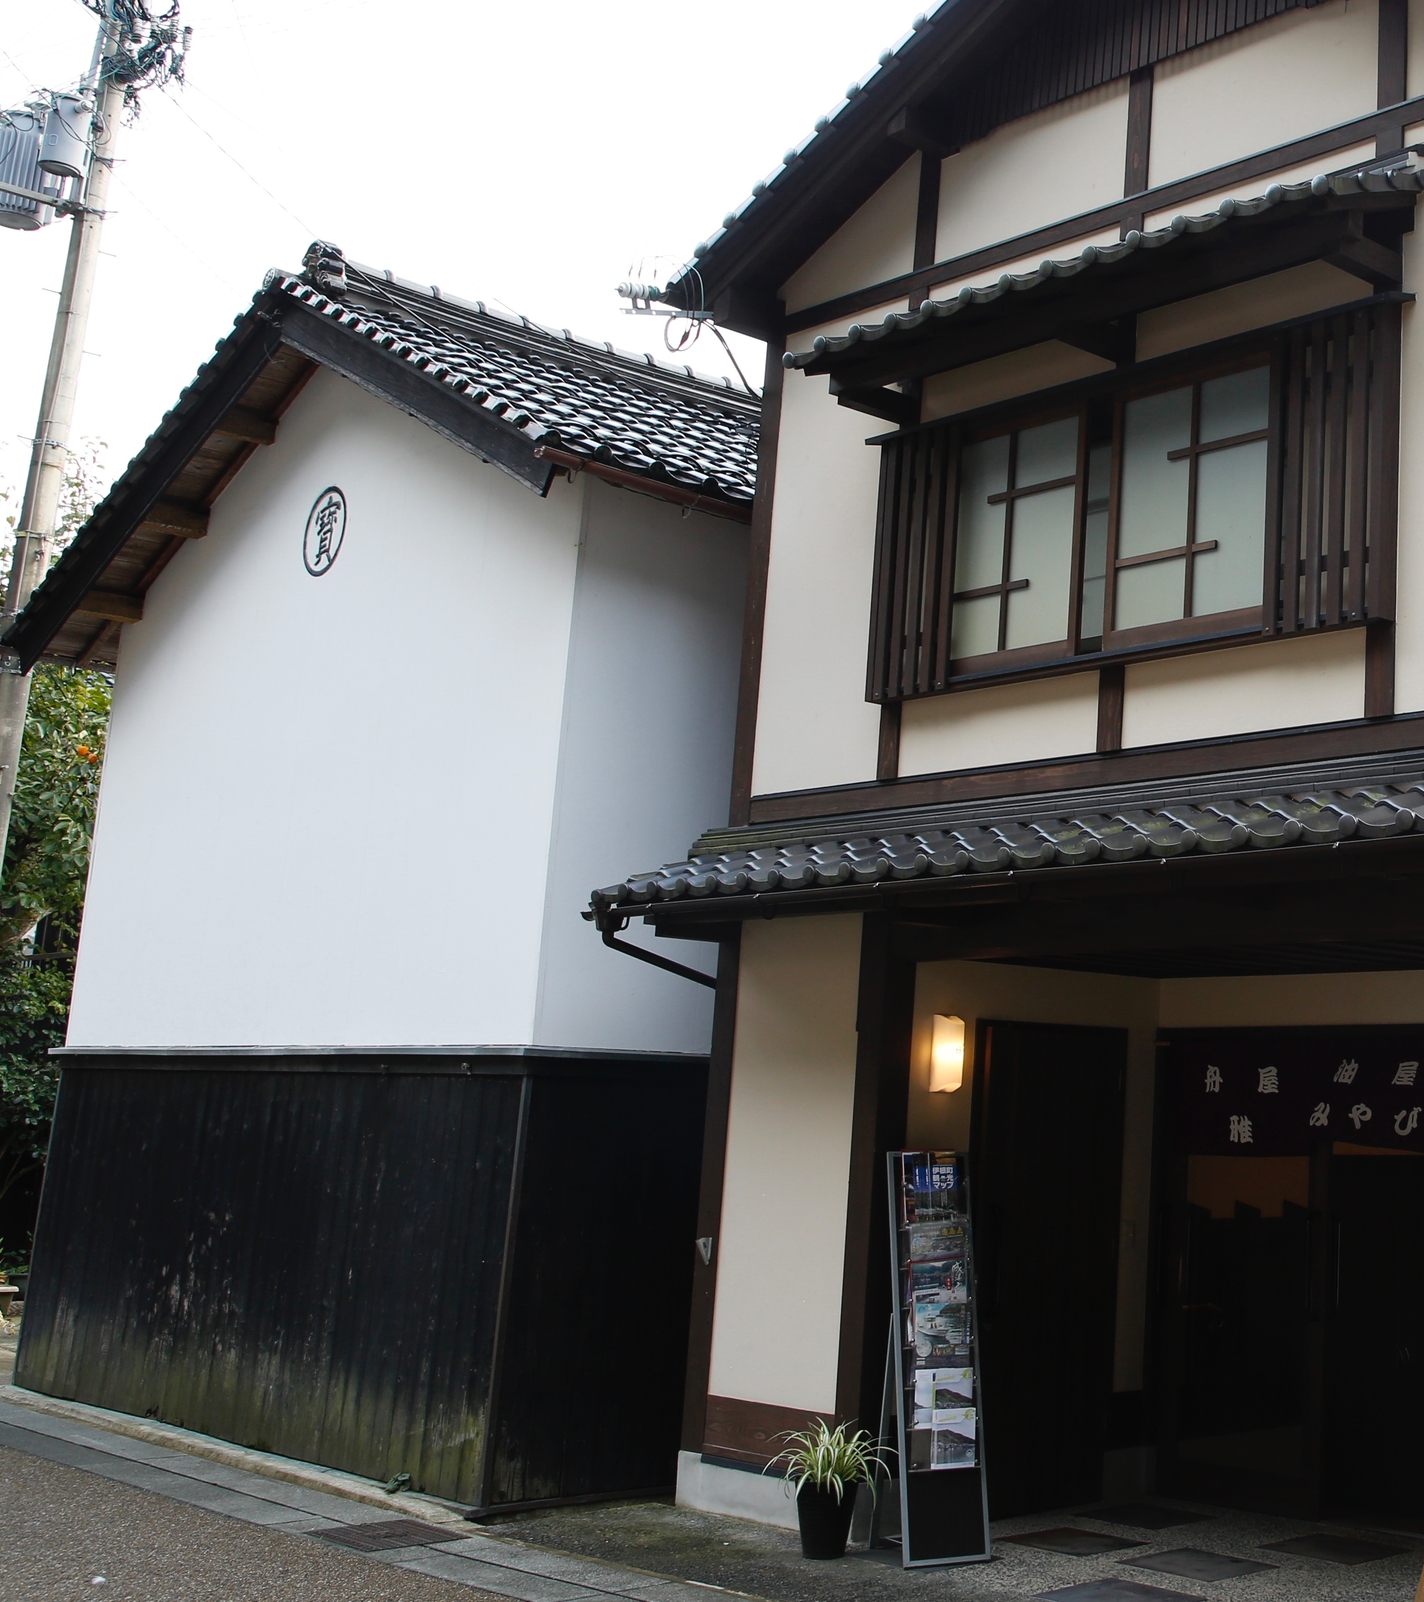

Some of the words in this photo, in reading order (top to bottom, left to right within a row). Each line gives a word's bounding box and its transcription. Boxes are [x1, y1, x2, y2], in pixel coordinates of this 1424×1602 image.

[1204, 1064, 1280, 1094] 舟屋
[1333, 1058, 1420, 1086] 油屋
[1229, 1114, 1254, 1144] 雅
[1309, 1101, 1423, 1136] みやび
